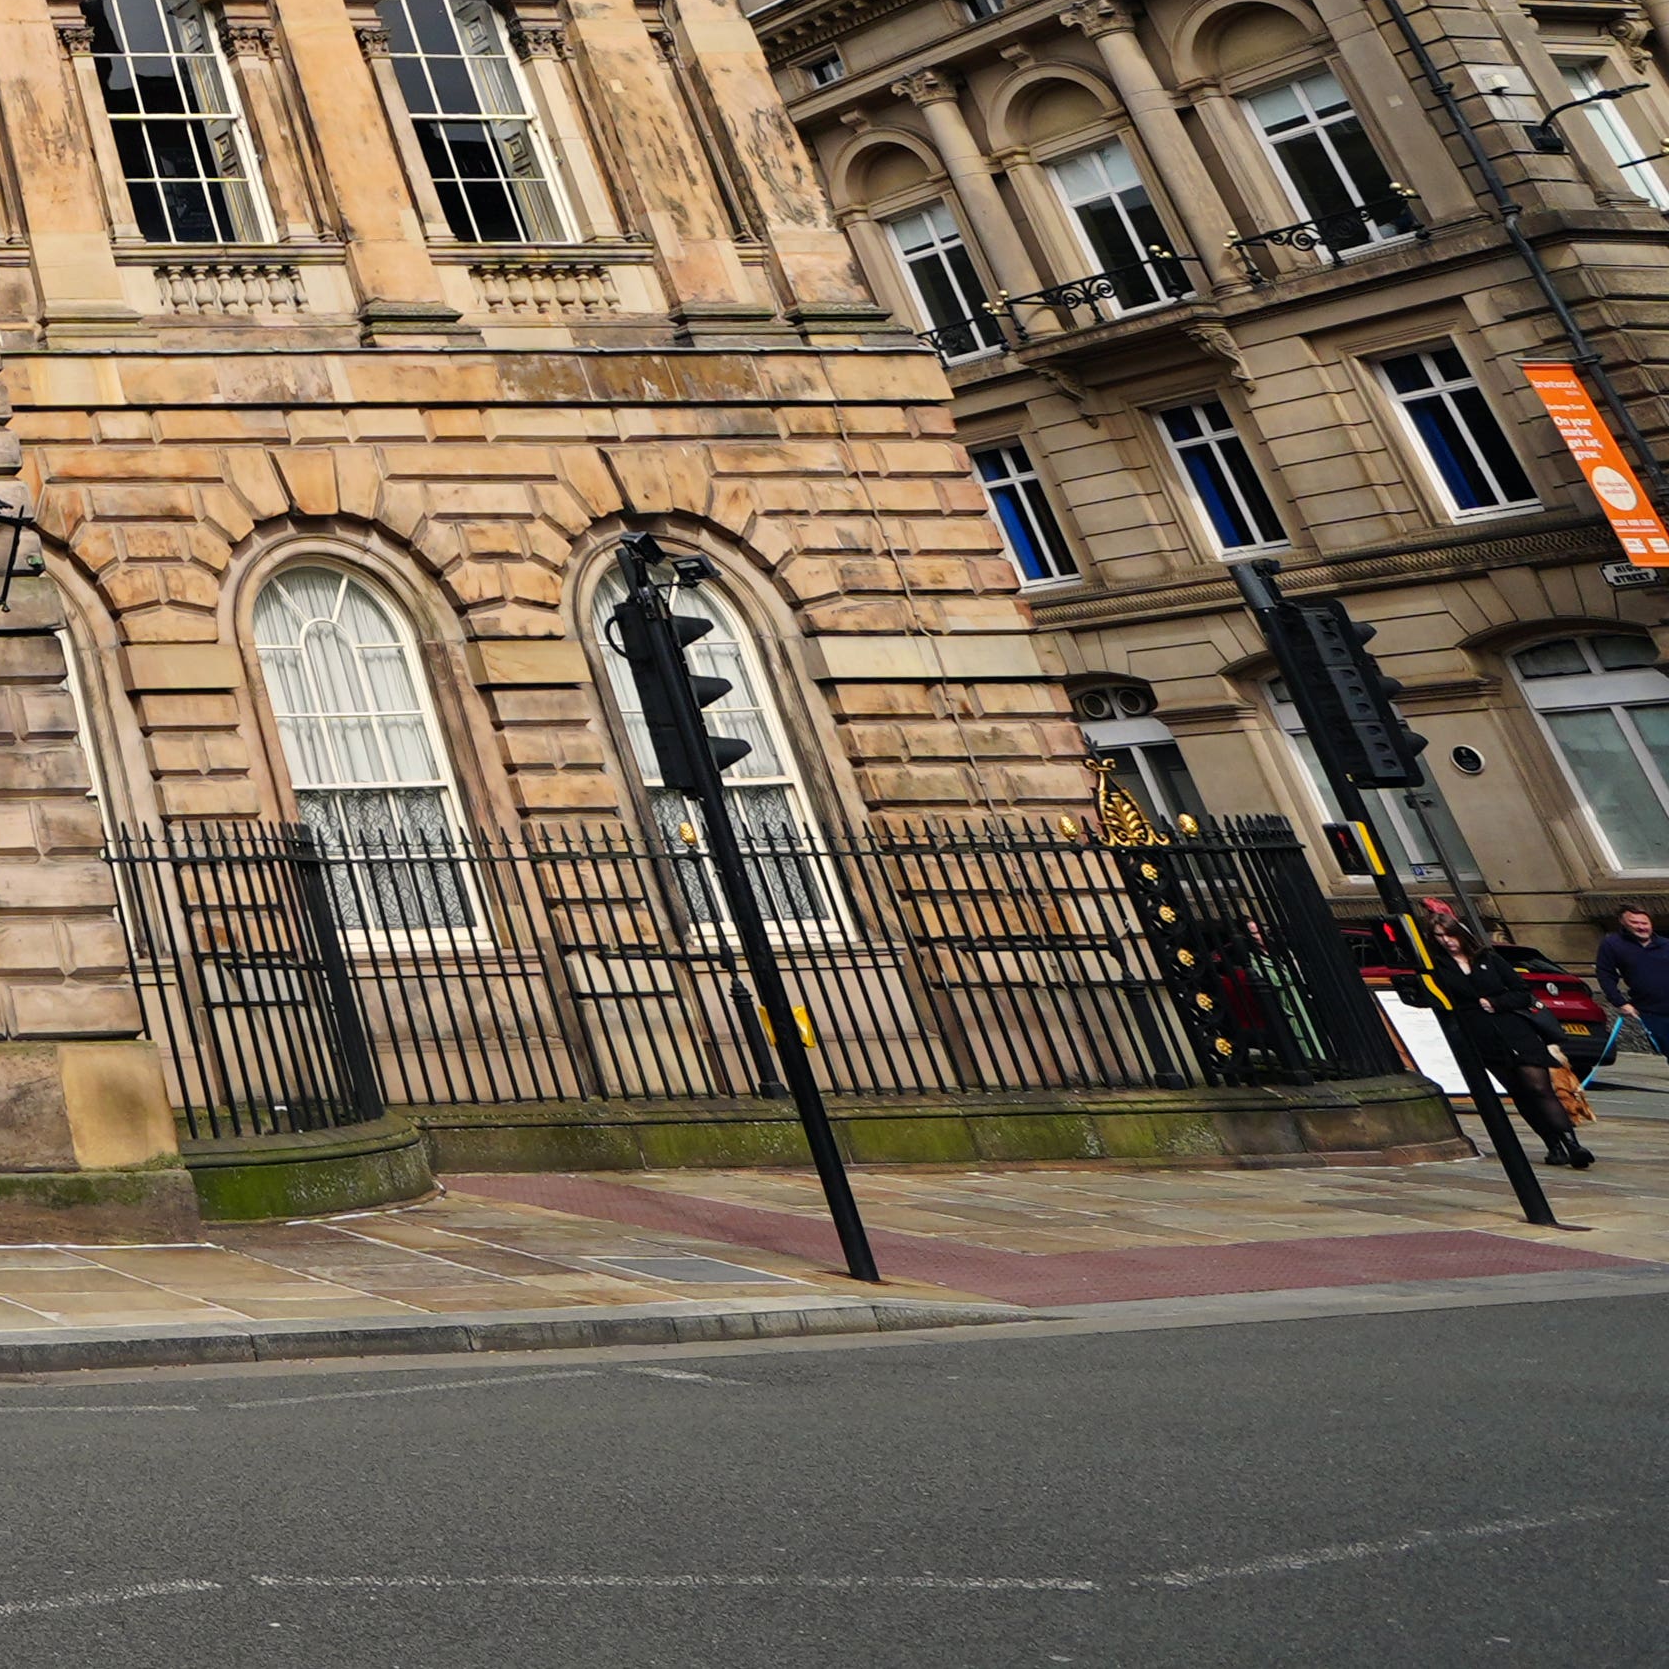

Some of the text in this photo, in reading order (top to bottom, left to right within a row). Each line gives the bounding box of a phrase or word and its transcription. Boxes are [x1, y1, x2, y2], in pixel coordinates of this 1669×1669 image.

[1553, 416, 1592, 427] On your
[1613, 572, 1650, 583] STREET
